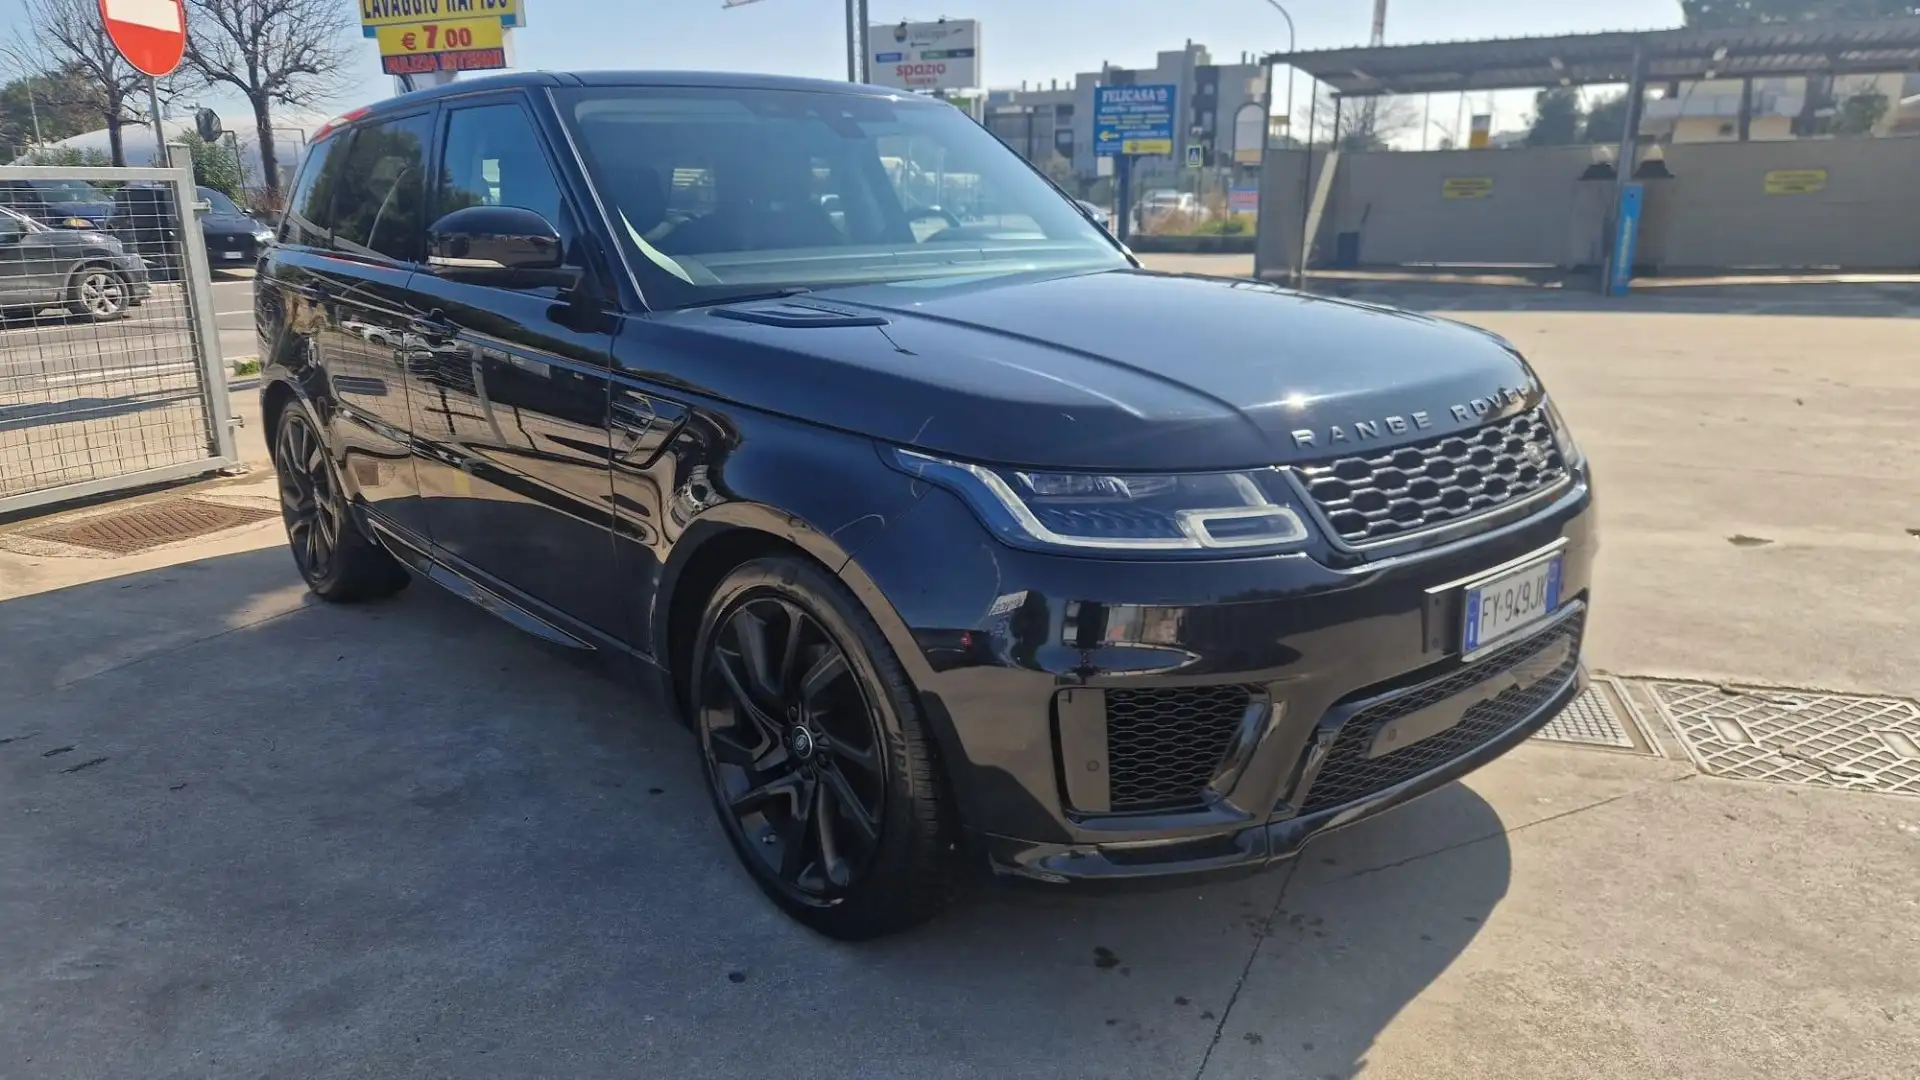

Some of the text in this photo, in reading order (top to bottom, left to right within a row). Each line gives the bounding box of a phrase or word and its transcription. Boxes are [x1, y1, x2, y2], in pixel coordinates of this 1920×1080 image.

[401, 32, 417, 50] €
[896, 63, 946, 80] spazio
[1290, 411, 1433, 450] RANGE
